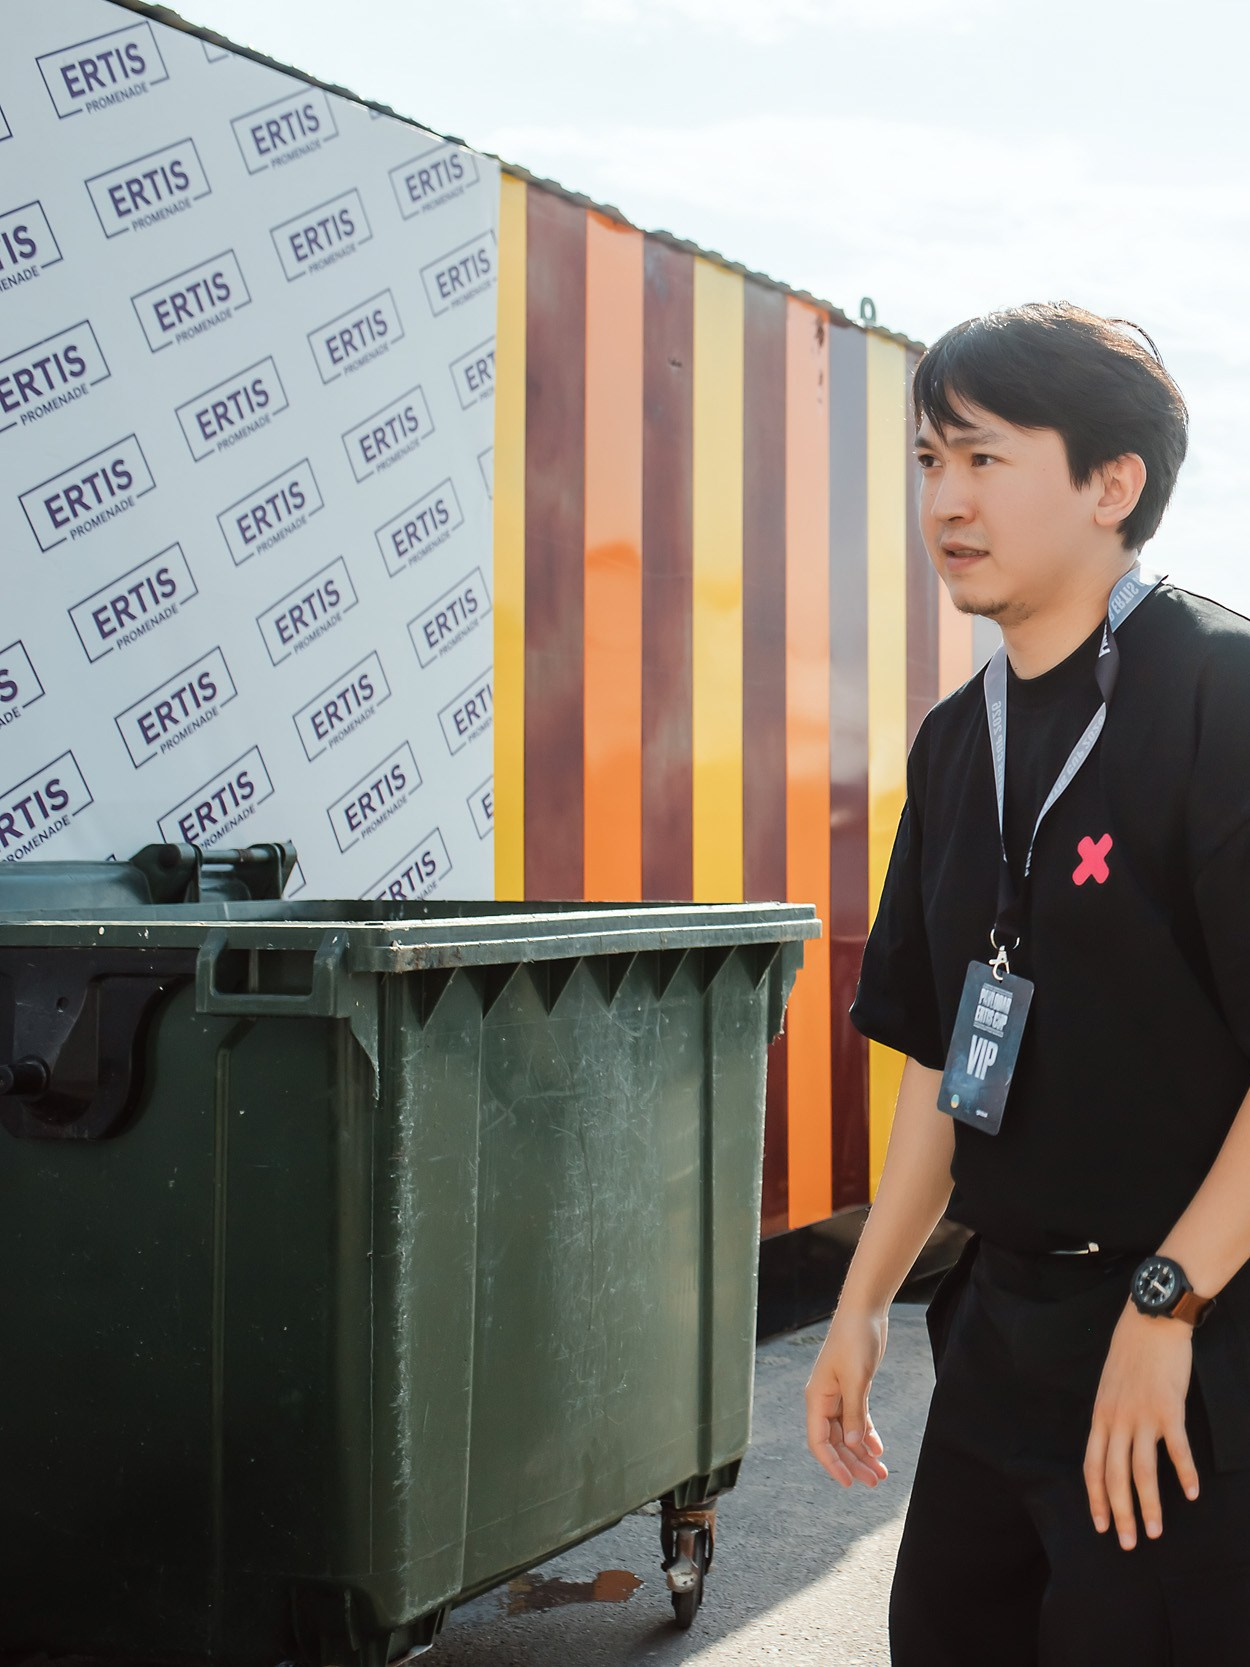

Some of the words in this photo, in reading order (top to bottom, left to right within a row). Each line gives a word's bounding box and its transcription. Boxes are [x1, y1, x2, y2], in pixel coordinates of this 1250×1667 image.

[60, 43, 146, 100] ERTIS
[85, 82, 149, 115] PROMENADE
[250, 104, 320, 156] ERTIS
[270, 139, 321, 170] PROMENADE
[107, 160, 190, 218] ERTIS
[405, 153, 463, 202] ERTIS
[132, 199, 192, 232] PROMENADE
[288, 208, 355, 263] ERTIS
[0, 225, 36, 270] IS
[307, 242, 357, 275] PROMENADE
[436, 248, 490, 298] ERTIS
[152, 272, 231, 332] ERTIS
[175, 309, 233, 345] PROMENADE
[325, 310, 389, 366] ERTIS
[0, 345, 86, 413] ERTIS
[342, 340, 390, 376] PROMENADE
[20, 383, 89, 426] PROMENADE
[196, 378, 270, 441] ERTIS
[216, 413, 272, 452] PROMENADE
[358, 407, 419, 464] ERTIS
[43, 458, 133, 529] ERTIS
[235, 481, 306, 545] ERTIS
[70, 497, 135, 541] PROMENADE
[256, 515, 308, 556] PROMENADE
[391, 499, 450, 560] ERTIS
[408, 529, 452, 567] PROMENADE
[92, 568, 177, 640] ERTIS
[116, 603, 179, 651] PROMENADE
[274, 579, 341, 645] ERTIS
[422, 589, 479, 651] ERTIS
[293, 613, 342, 655] PROMENADE
[438, 620, 481, 658] PROMENADE
[137, 672, 218, 746] ERTIS
[160, 707, 219, 755] PROMENADE
[310, 674, 374, 741] ERTIS
[328, 707, 376, 750] PROMENADE
[0, 779, 69, 853] RTIS
[178, 771, 254, 843] ERTIS
[343, 764, 407, 833] ERTIS
[360, 797, 409, 843] PROMENADE
[2, 815, 70, 862] ROMENADE
[201, 804, 256, 851] ROMENADE
[966, 1034, 998, 1081] VIP
